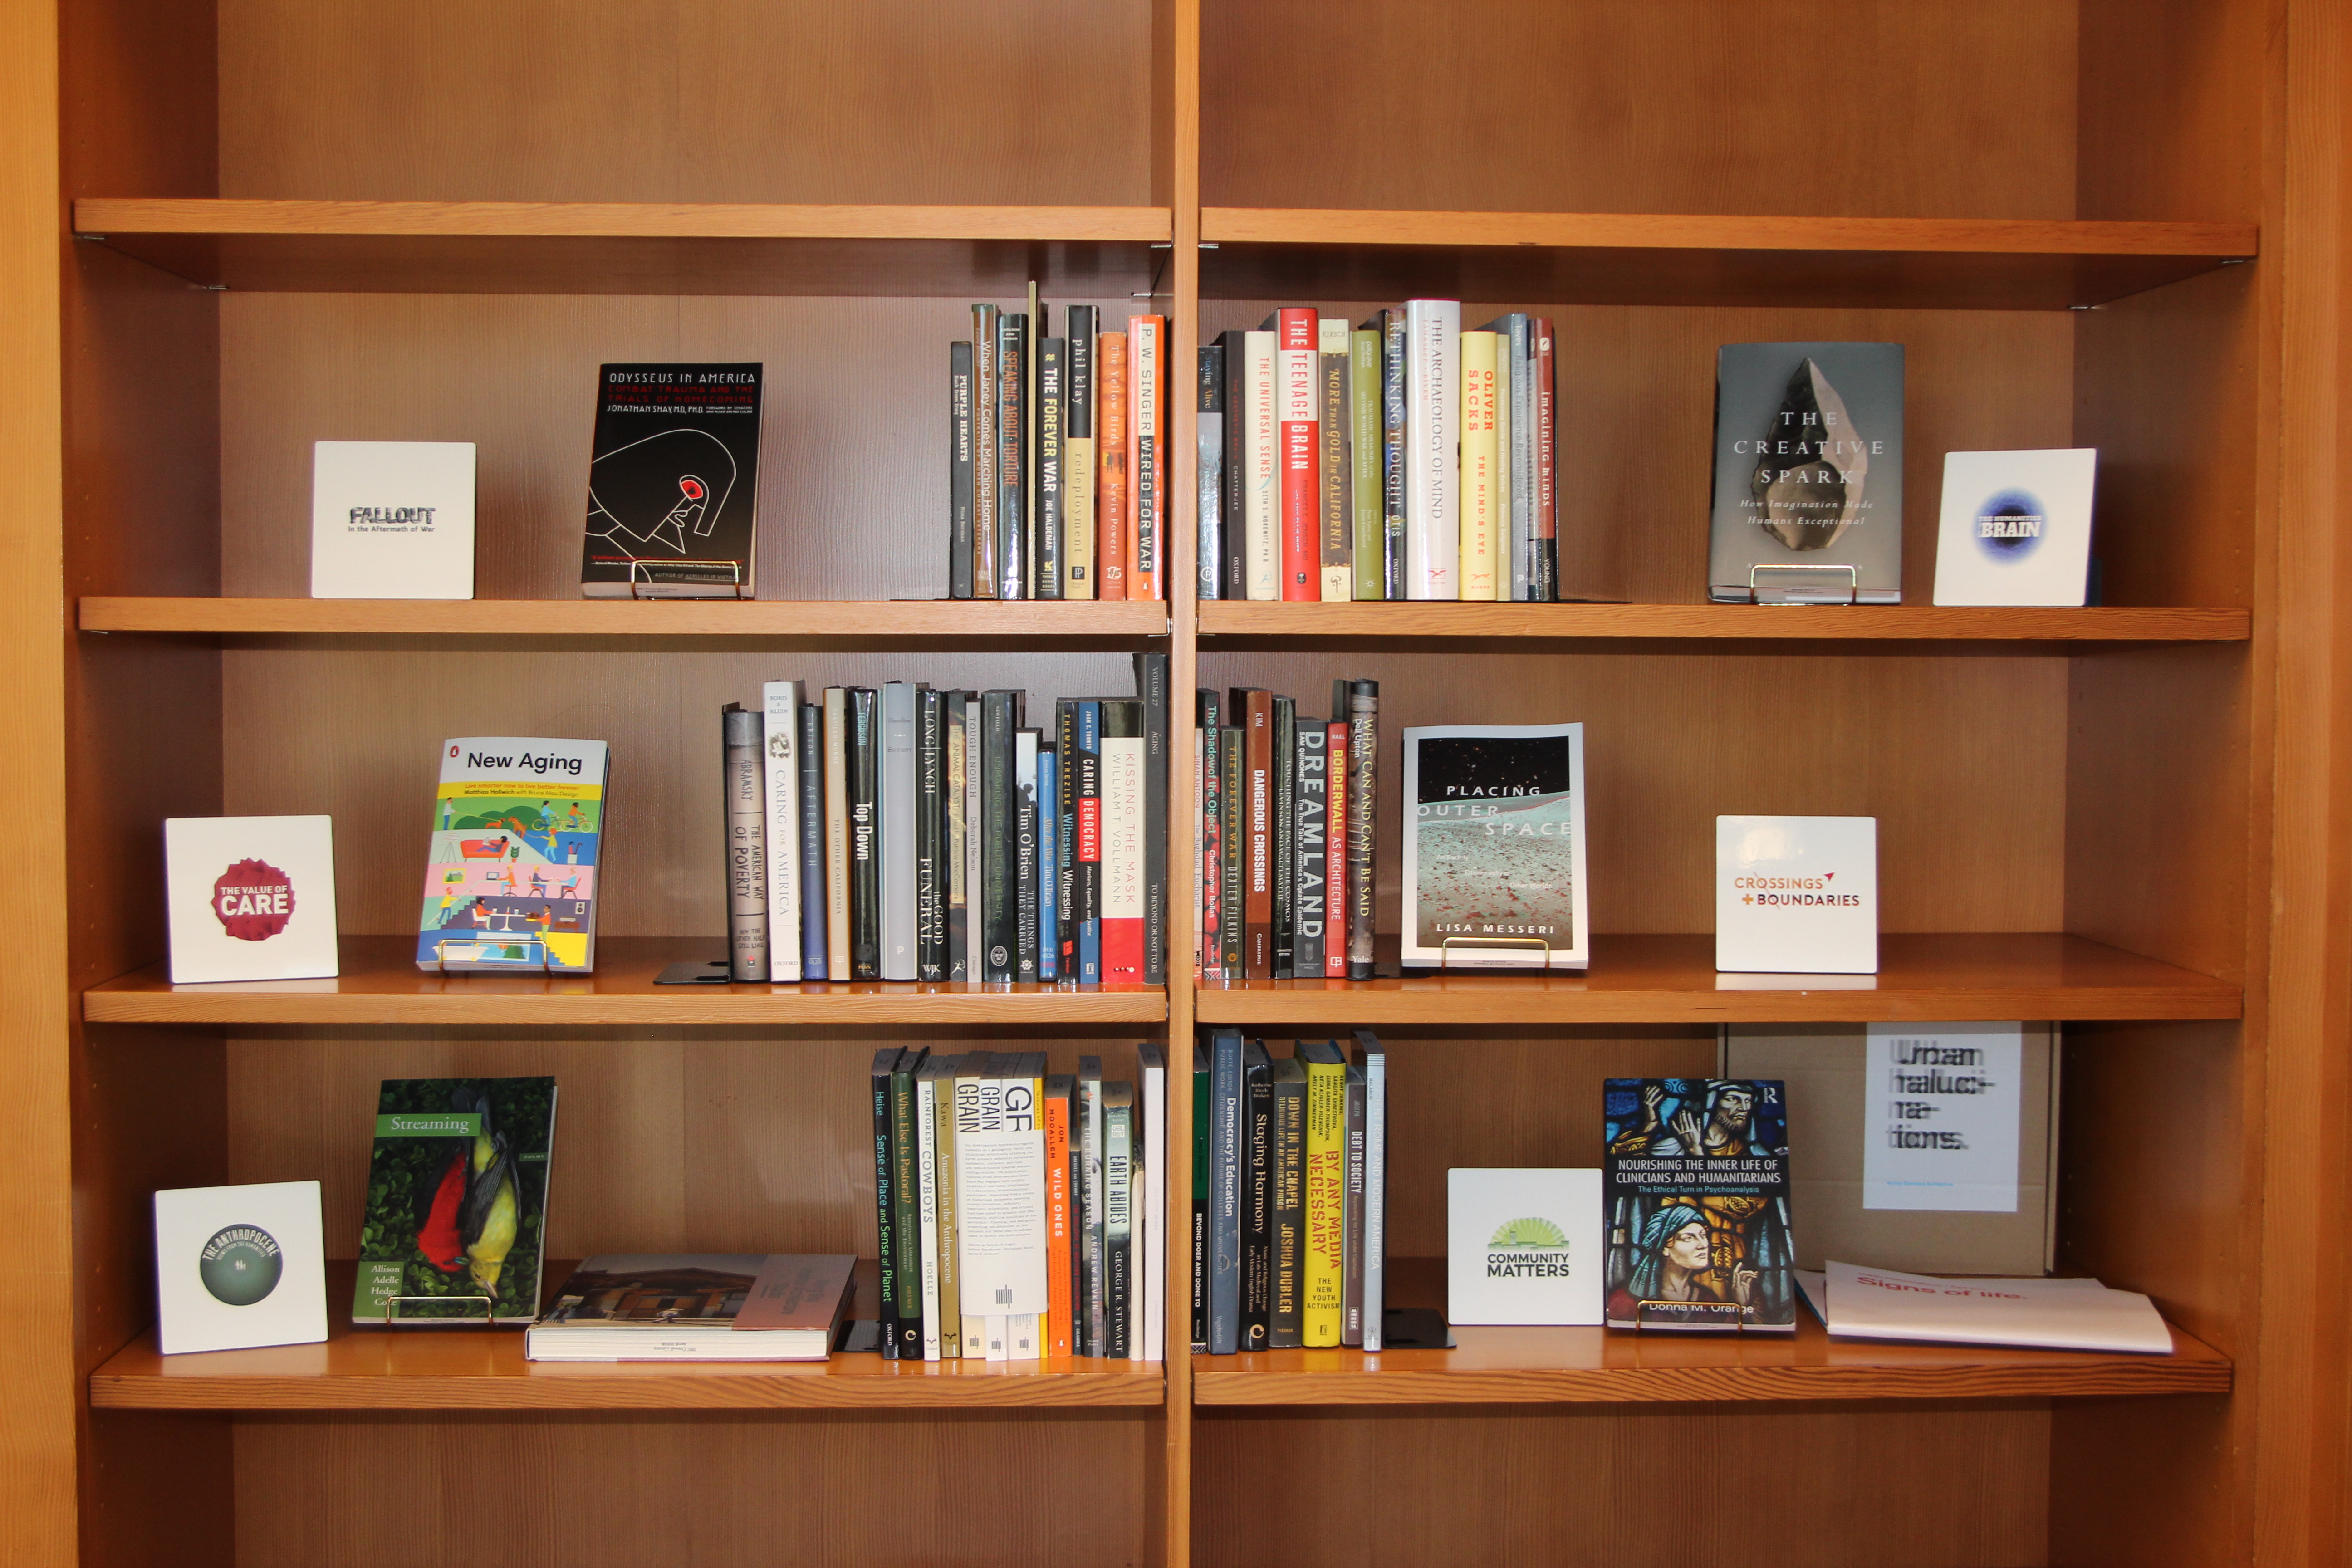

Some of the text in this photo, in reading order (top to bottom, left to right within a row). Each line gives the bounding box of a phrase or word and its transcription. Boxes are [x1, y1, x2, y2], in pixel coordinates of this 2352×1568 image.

[609, 373, 755, 383] ODYSSEUS IN AMERICA
[1072, 338, 1087, 405] phil klay
[1328, 368, 1340, 405] MORE
[1111, 345, 1119, 446] The Yellow Birds
[1290, 318, 1309, 470] THE TEENAGE BRAIN
[1468, 369, 1479, 431] SACKS
[1484, 370, 1493, 431] OLIVER
[1043, 368, 1058, 493] THE FOREVER WAR
[1259, 358, 1271, 478] THE UNIVERSAL SENSE
[1431, 316, 1443, 519] THE ARCHAEOLOGY OF MIND
[1780, 412, 1838, 425] THE
[960, 420, 968, 462] HEARTS
[981, 341, 992, 531] When Janey Comes Marching Home
[1139, 328, 1152, 569] P. W. SINGER WIRED FOR WAR
[1327, 430, 1341, 463] GOLD
[1734, 441, 1885, 455] CREATIVE
[1330, 465, 1337, 473] IN
[1761, 470, 1856, 485] SPARK
[350, 507, 436, 524] FALLOUT
[1072, 454, 1085, 553] redeployment
[1329, 475, 1341, 549] CALIFORNIA
[1747, 515, 1865, 528] Humans Exceptional
[1981, 522, 2042, 537] BRAIN
[1207, 706, 1217, 725] The
[1362, 718, 1374, 755] WHAT
[468, 752, 582, 775] New Aging
[775, 769, 787, 825] CARING
[1208, 781, 1217, 797] the
[1447, 786, 1540, 796] PLACING
[1019, 805, 1032, 830] Tim
[1083, 759, 1095, 860] CARING DEMOCRACY
[1207, 799, 1217, 834] Object
[1362, 794, 1371, 821] AND
[1417, 805, 1498, 816] OUTER
[853, 801, 872, 861] Top Down
[1126, 753, 1135, 903] KISSING THE MASK
[1254, 770, 1265, 893] DANGEROUS CROSSINGS
[1303, 731, 1325, 938] DREAMLAND
[1332, 750, 1343, 920] BORDERWALL AS ARCHITECTURE
[1485, 822, 1572, 836] SPACE
[220, 885, 288, 895] THE VALUE OF
[777, 850, 790, 916] AMERICA
[1735, 877, 1823, 889] CROSSINGS
[221, 893, 289, 916] CARE
[1758, 894, 1859, 906] BOUNDARIES
[391, 1116, 470, 1134] Streaming
[877, 1135, 886, 1165] Sense
[1351, 1131, 1362, 1194] DEBT TO SOCIETY
[1618, 1160, 1778, 1170] NOURISHING THE INNER LIFE OF
[922, 1150, 933, 1223] COWBOYS
[1252, 1113, 1267, 1234] Staging Harmony
[1616, 1172, 1781, 1183] CLINICIANS AND HUMANITARIANS
[879, 1180, 889, 1205] Place
[1109, 1156, 1127, 1224] EARTH ABIDES
[1225, 1165, 1235, 1217] Education
[1309, 1154, 1327, 1254] NECESSARY
[1705, 1186, 1759, 1194] Psychoanalysis
[880, 1209, 888, 1223] and
[941, 1153, 953, 1284] Amazonia in the Anthropocene
[1054, 1204, 1063, 1237] ONES
[1326, 1151, 1342, 1269] BY ANY MEDIA
[202, 1229, 279, 1260] THE ANTHROPOCENE
[880, 1226, 890, 1255] Sense
[882, 1258, 890, 1266] of
[1487, 1253, 1569, 1264] COMMUNITY
[1487, 1264, 1569, 1277] MATTERS
[371, 1287, 398, 1296] Hedge
[882, 1270, 892, 1302] Planet
[1858, 1277, 1936, 1293] Signs
[1195, 1298, 1201, 1307] TO
